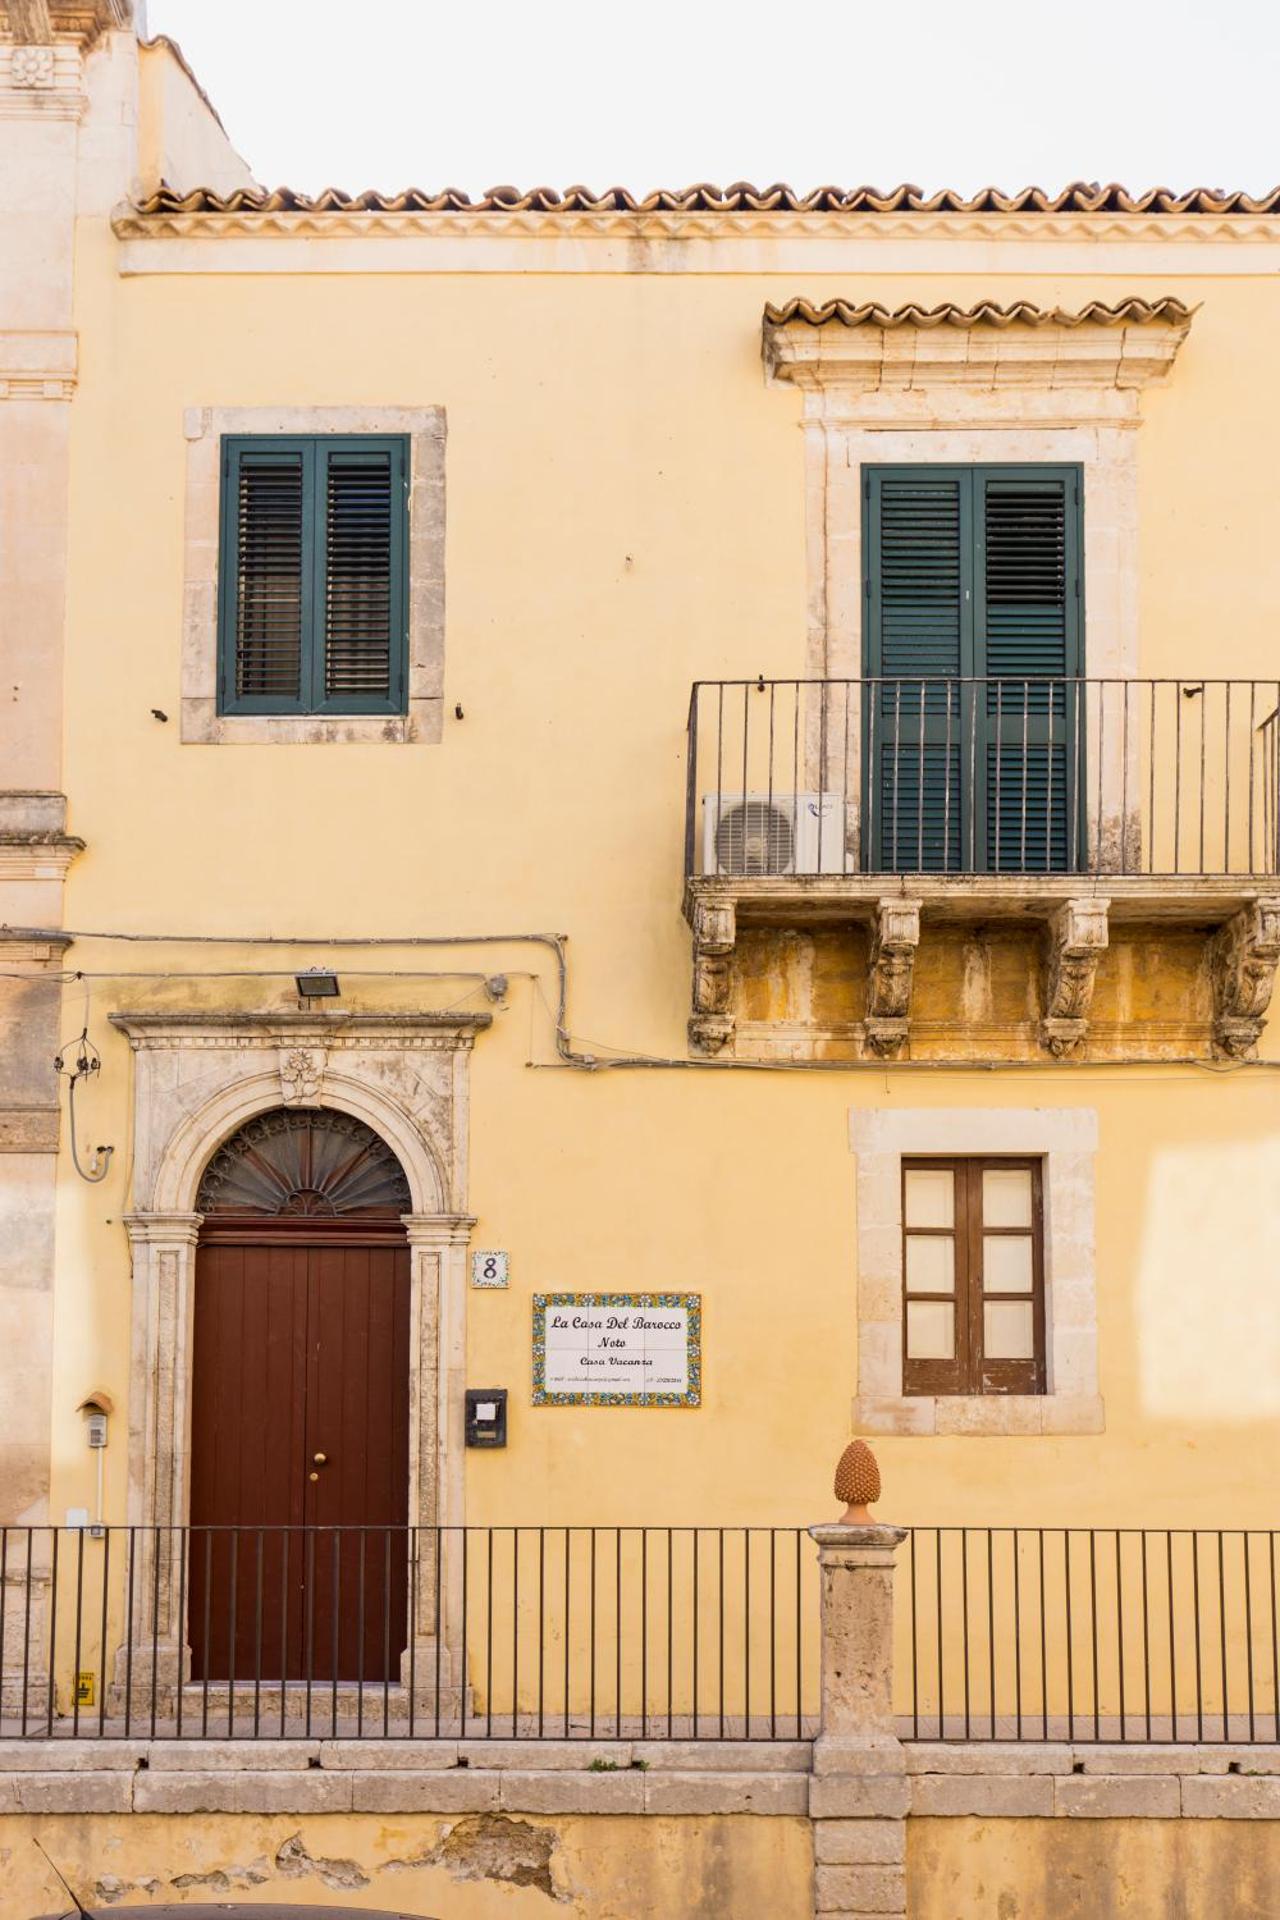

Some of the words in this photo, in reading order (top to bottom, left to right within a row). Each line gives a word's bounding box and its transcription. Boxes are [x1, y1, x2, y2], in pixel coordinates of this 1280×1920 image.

[483, 1257, 497, 1279] 8
[551, 1315, 568, 1329] La
[572, 1316, 602, 1329] Casa
[606, 1316, 629, 1330] Del
[632, 1316, 681, 1330] Barocco
[597, 1336, 626, 1348] Noto
[580, 1356, 605, 1366] Casa
[608, 1356, 653, 1366] Vacanza
